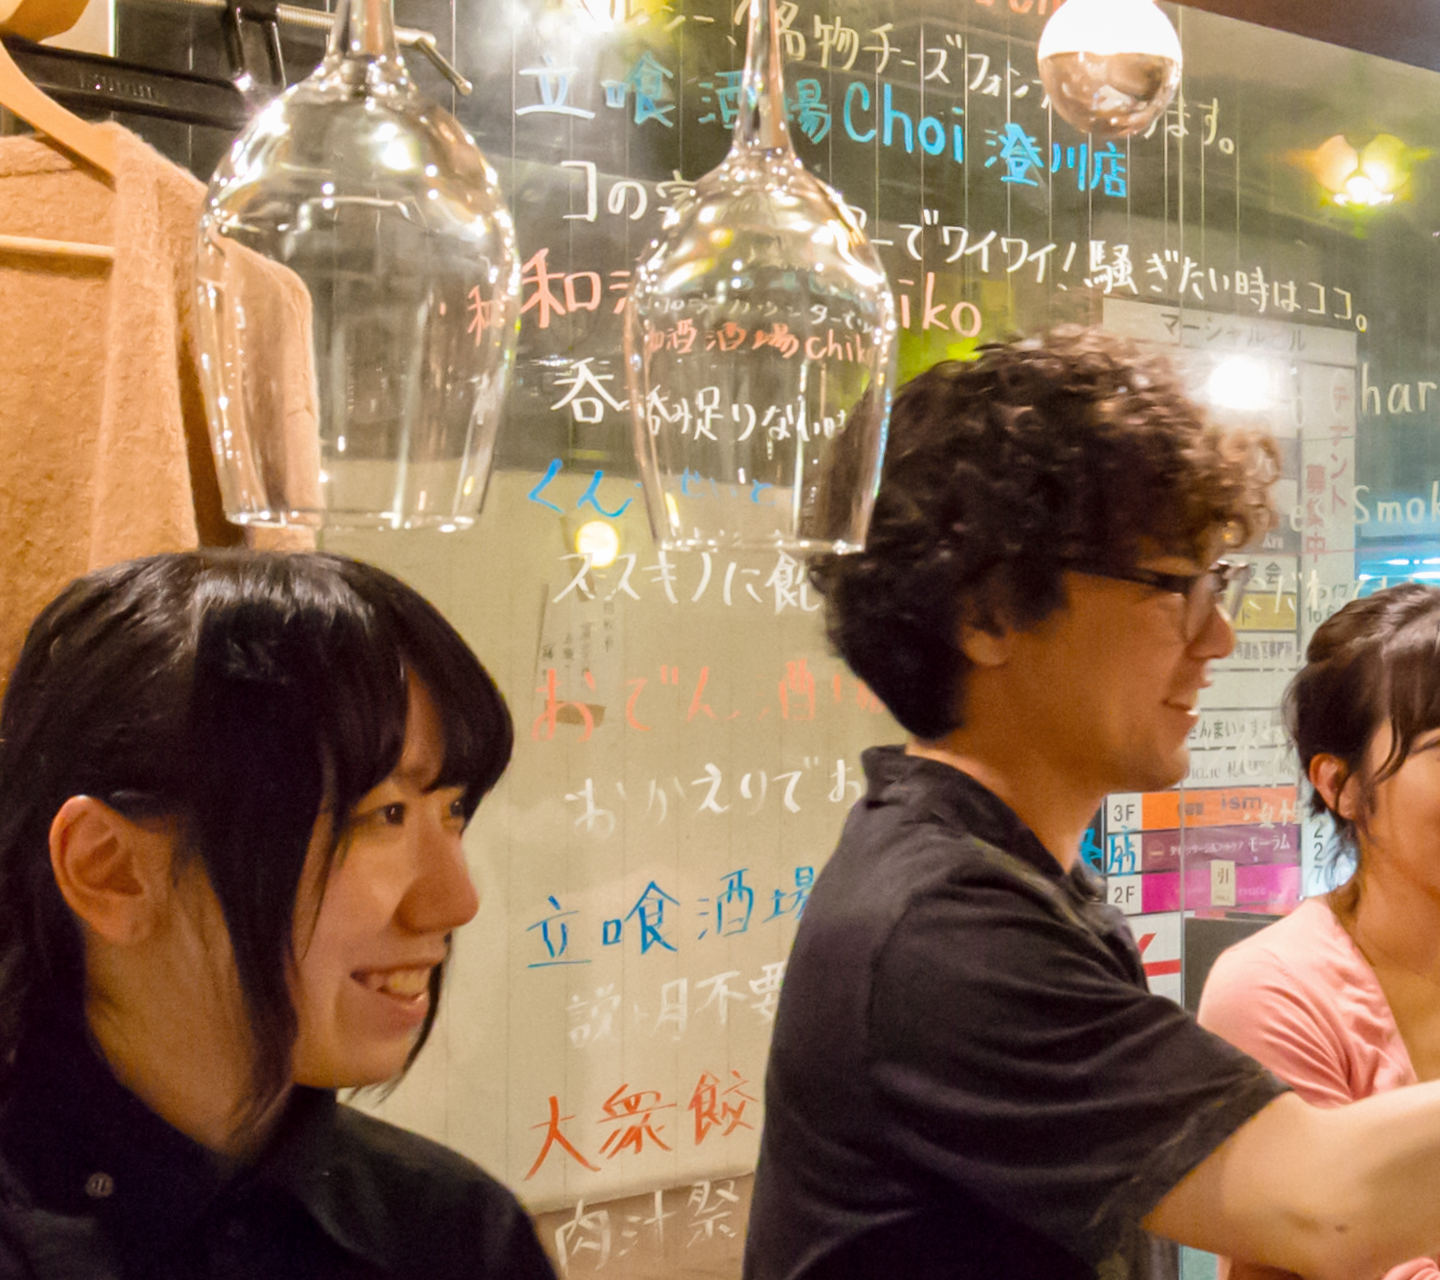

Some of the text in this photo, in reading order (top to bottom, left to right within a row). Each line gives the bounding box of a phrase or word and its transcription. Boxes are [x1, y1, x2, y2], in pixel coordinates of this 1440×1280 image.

[983, 122, 1127, 198] 澄川店
[1113, 804, 1136, 822] 3F
